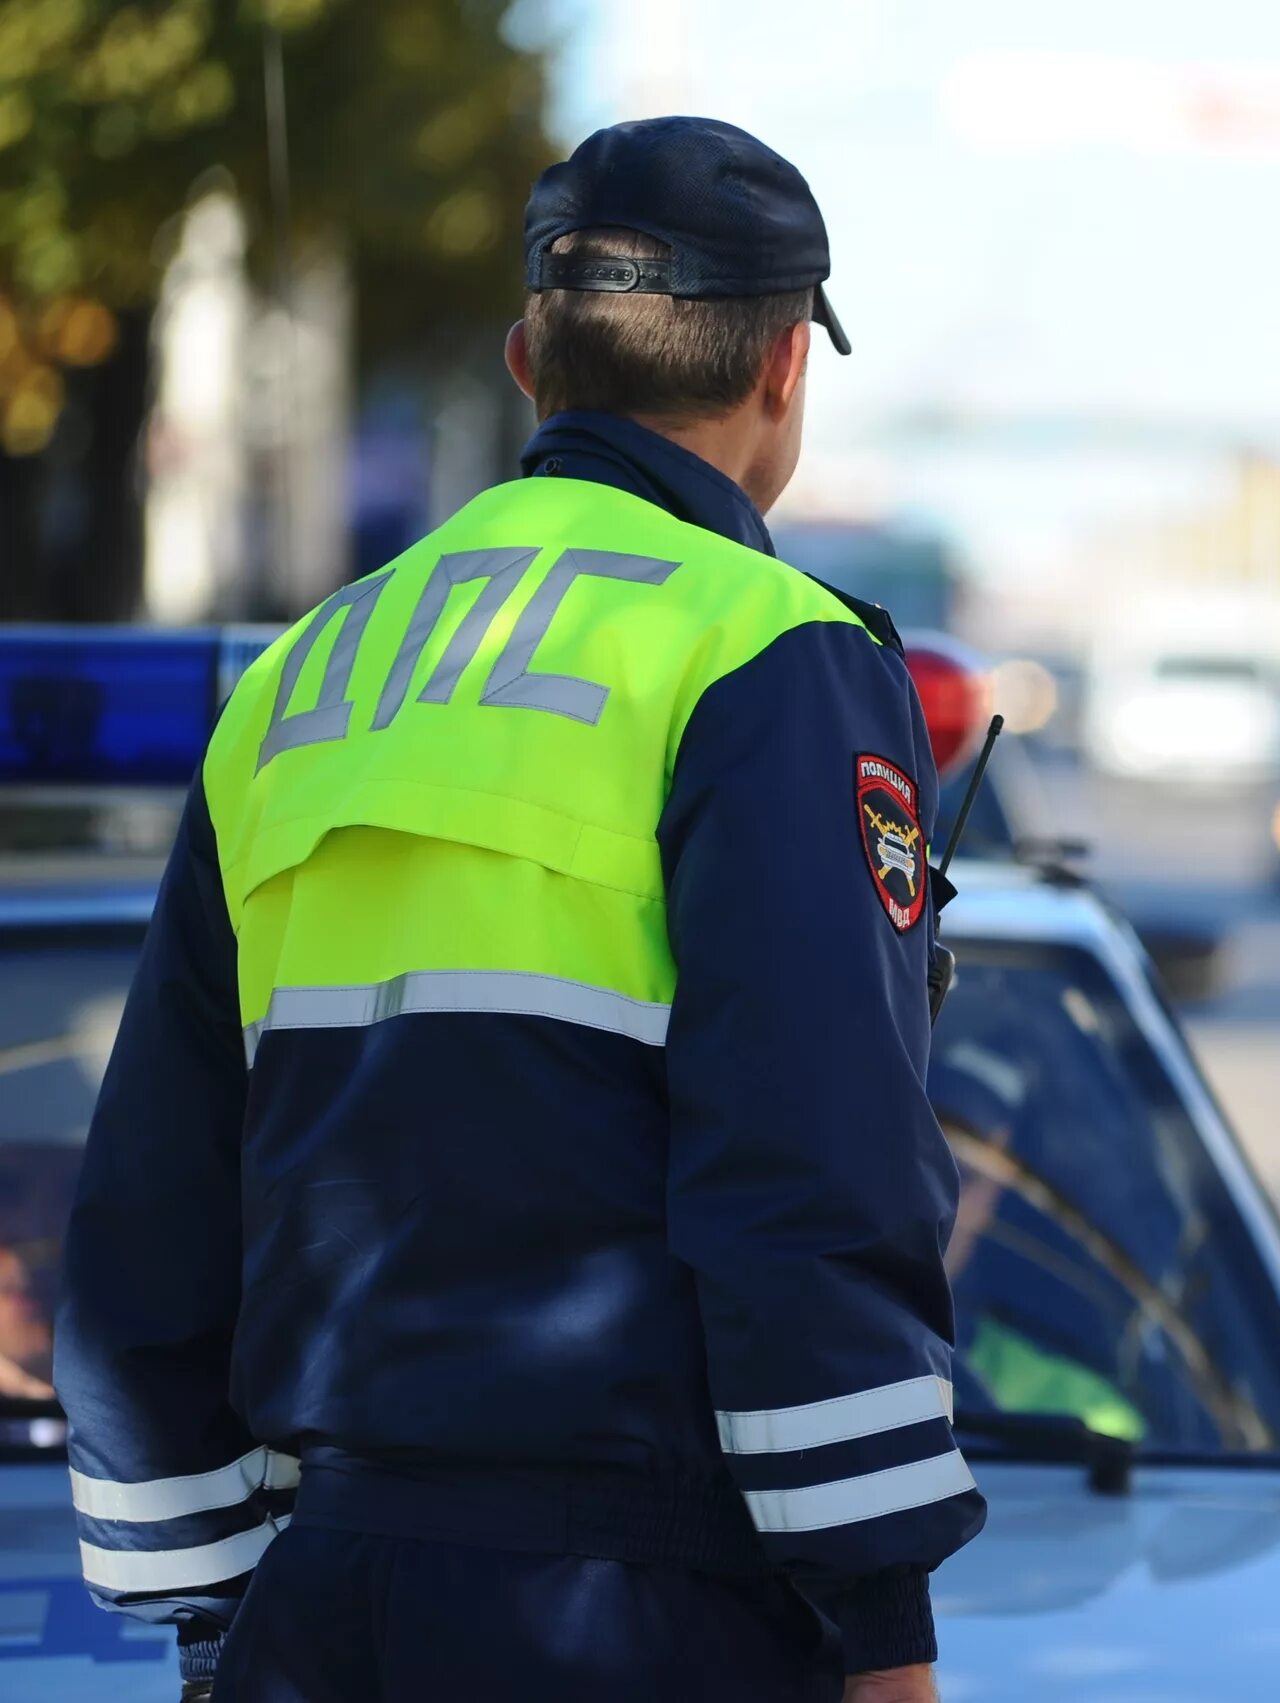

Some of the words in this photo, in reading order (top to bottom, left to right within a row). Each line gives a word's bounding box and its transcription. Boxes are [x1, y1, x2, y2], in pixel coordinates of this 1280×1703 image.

[254, 546, 683, 779] ДПС
[861, 761, 911, 804] ПОЛИЦИЯ
[889, 897, 910, 928] МВД
